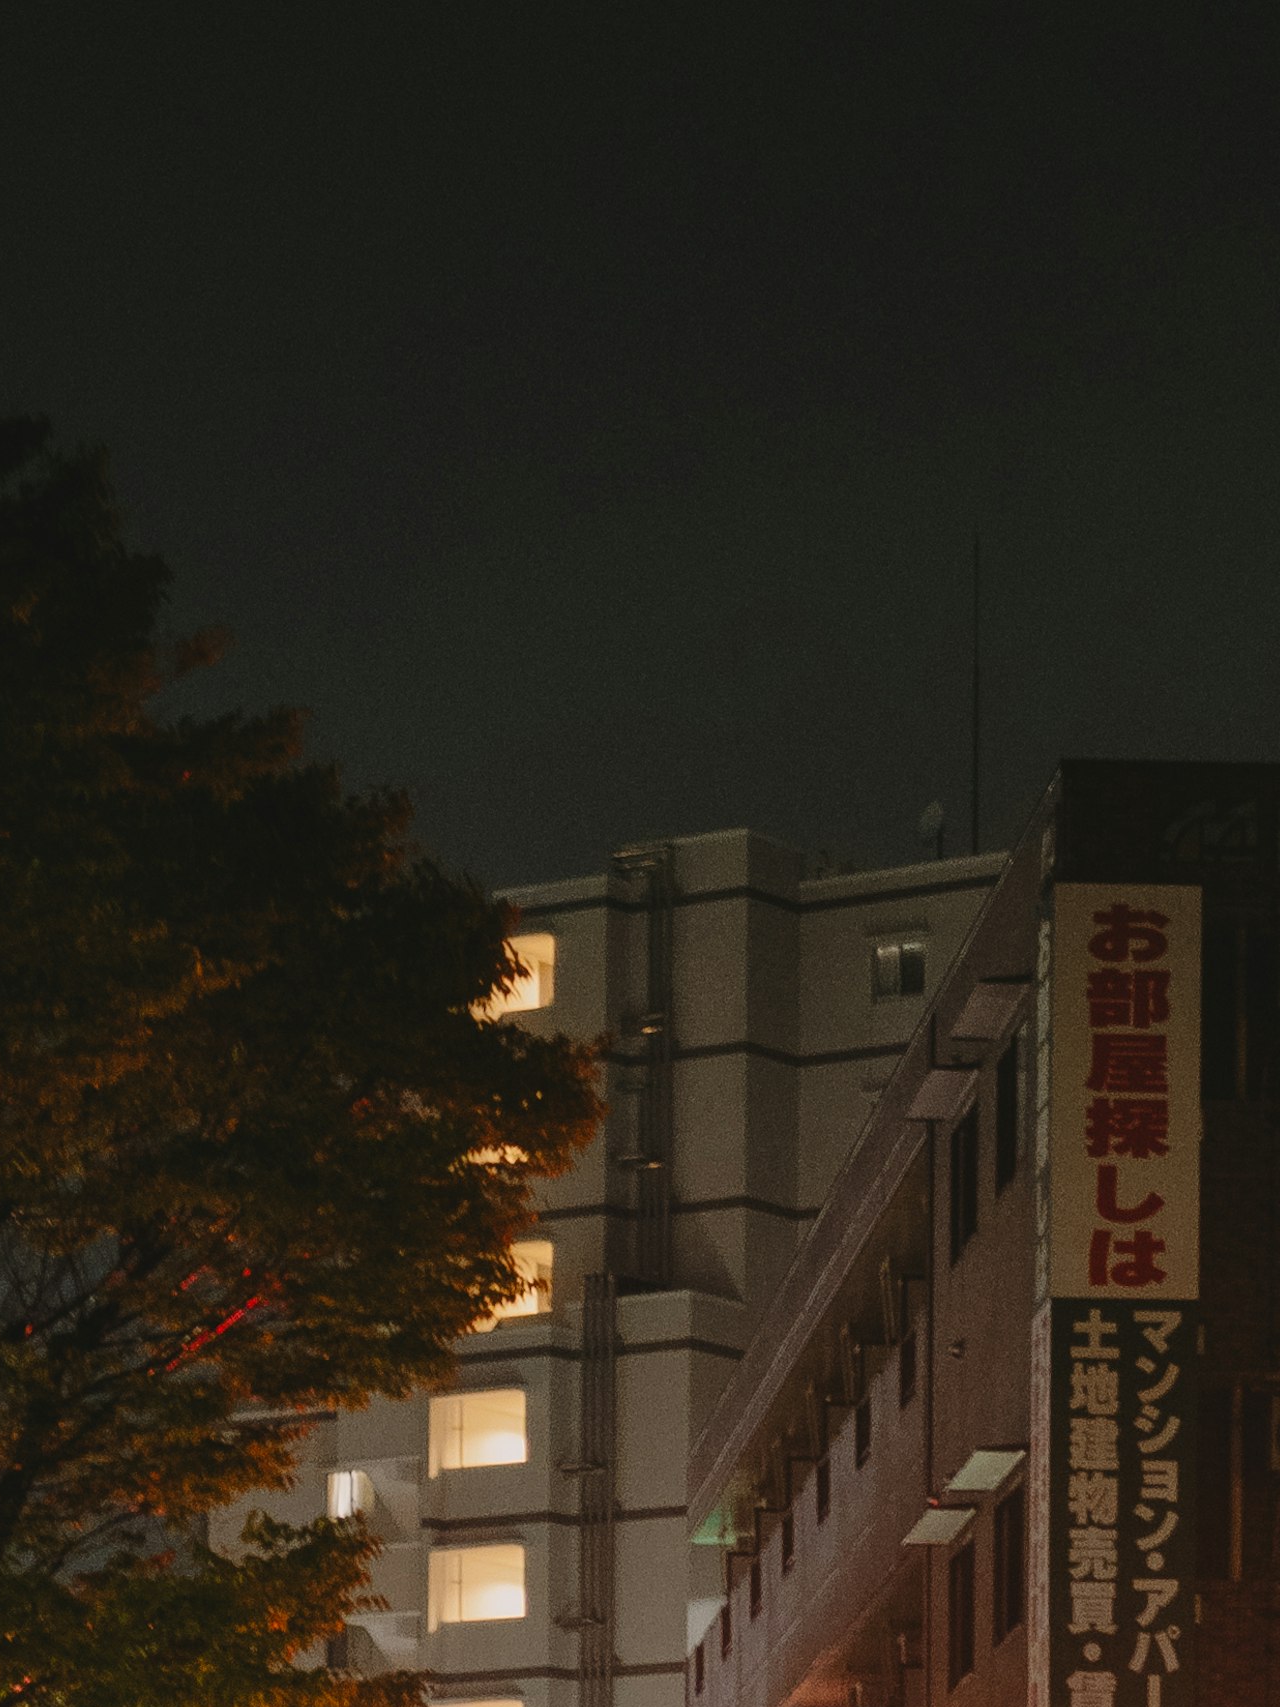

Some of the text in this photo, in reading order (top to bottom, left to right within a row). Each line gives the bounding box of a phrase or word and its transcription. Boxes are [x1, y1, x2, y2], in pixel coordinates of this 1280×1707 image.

[1084, 903, 1170, 1288] お部屋探しは
